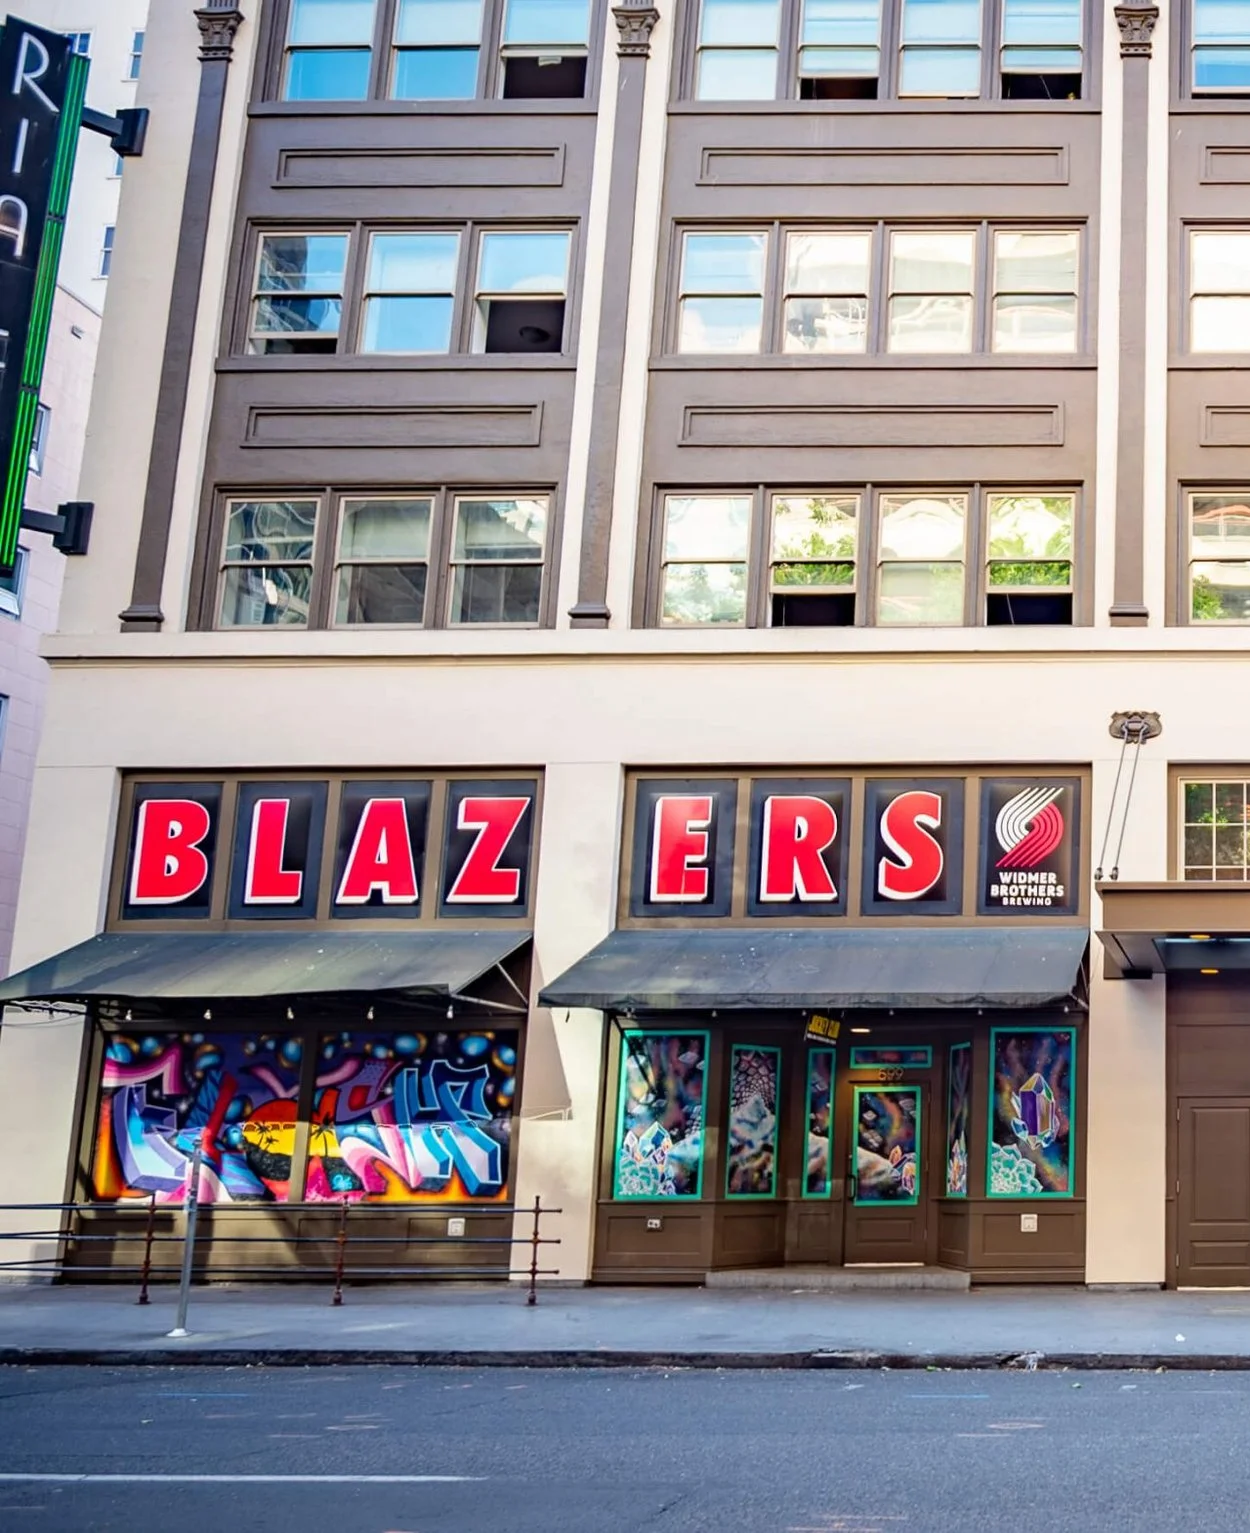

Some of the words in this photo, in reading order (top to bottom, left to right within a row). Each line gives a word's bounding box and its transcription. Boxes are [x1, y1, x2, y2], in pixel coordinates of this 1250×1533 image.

[999, 872, 1057, 884] WIDMER
[990, 884, 1065, 897] BROTHERS
[1002, 897, 1052, 906] BREWING
